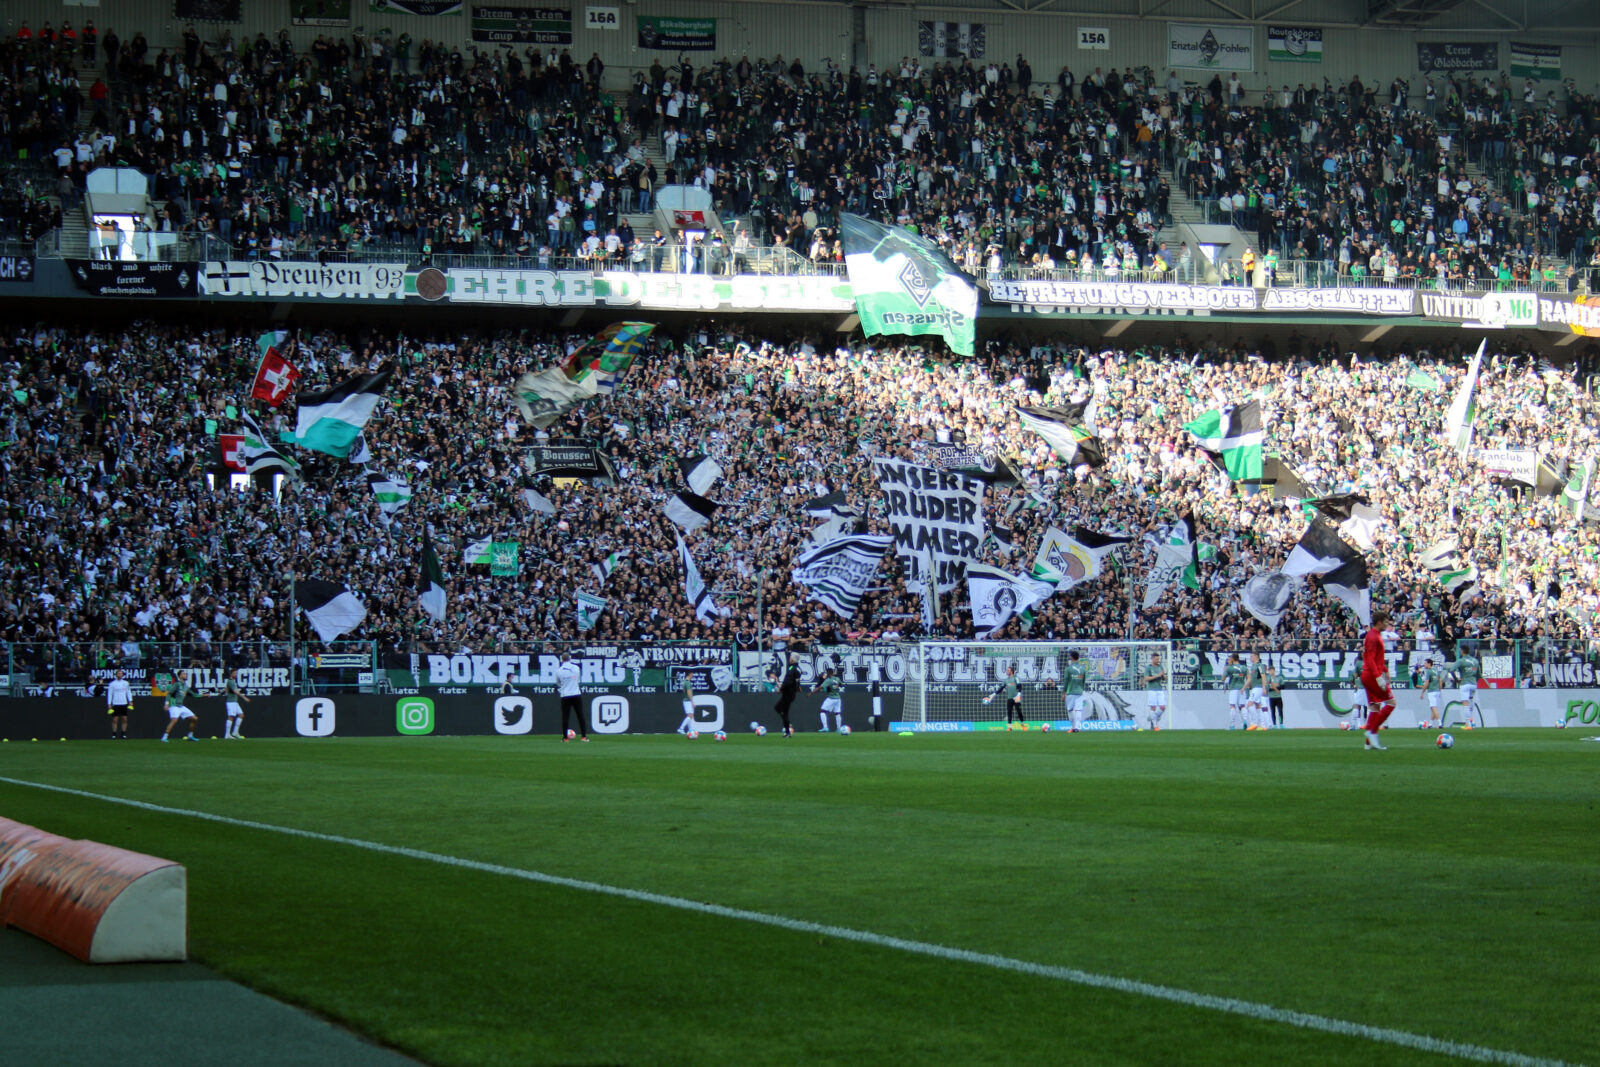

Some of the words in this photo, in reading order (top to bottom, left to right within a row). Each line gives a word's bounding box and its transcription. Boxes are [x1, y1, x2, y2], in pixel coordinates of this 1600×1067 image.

[480, 8, 513, 18] Dream
[534, 10, 564, 20] Team
[589, 12, 616, 24] 16A
[1081, 33, 1106, 44] 15A
[1171, 40, 1198, 51] Enztal
[1220, 43, 1250, 53] Fohlen
[1445, 45, 1471, 55] Treue
[1434, 57, 1483, 68] Gladbacher
[91, 262, 113, 271] black
[150, 264, 173, 272] white
[116, 276, 147, 285] forever
[449, 269, 595, 305] EHRE
[605, 271, 720, 309] DER
[989, 280, 1255, 309] BETRETUNGSVERBOTE
[1265, 289, 1412, 312] ABSCHAFFEN
[1421, 294, 1483, 319] UNITED
[1508, 299, 1532, 319] MG
[542, 449, 591, 460] Borussen
[938, 447, 980, 459] ROPKICK
[1480, 452, 1523, 462] Fanclub
[892, 522, 979, 559] MMER
[641, 648, 731, 662] FRONTLINE
[428, 652, 626, 684] BÖKELBRG
[1204, 652, 1404, 678] VTUSSTAT
[174, 667, 290, 688] VILLCHER
[1565, 699, 1600, 725] FO
